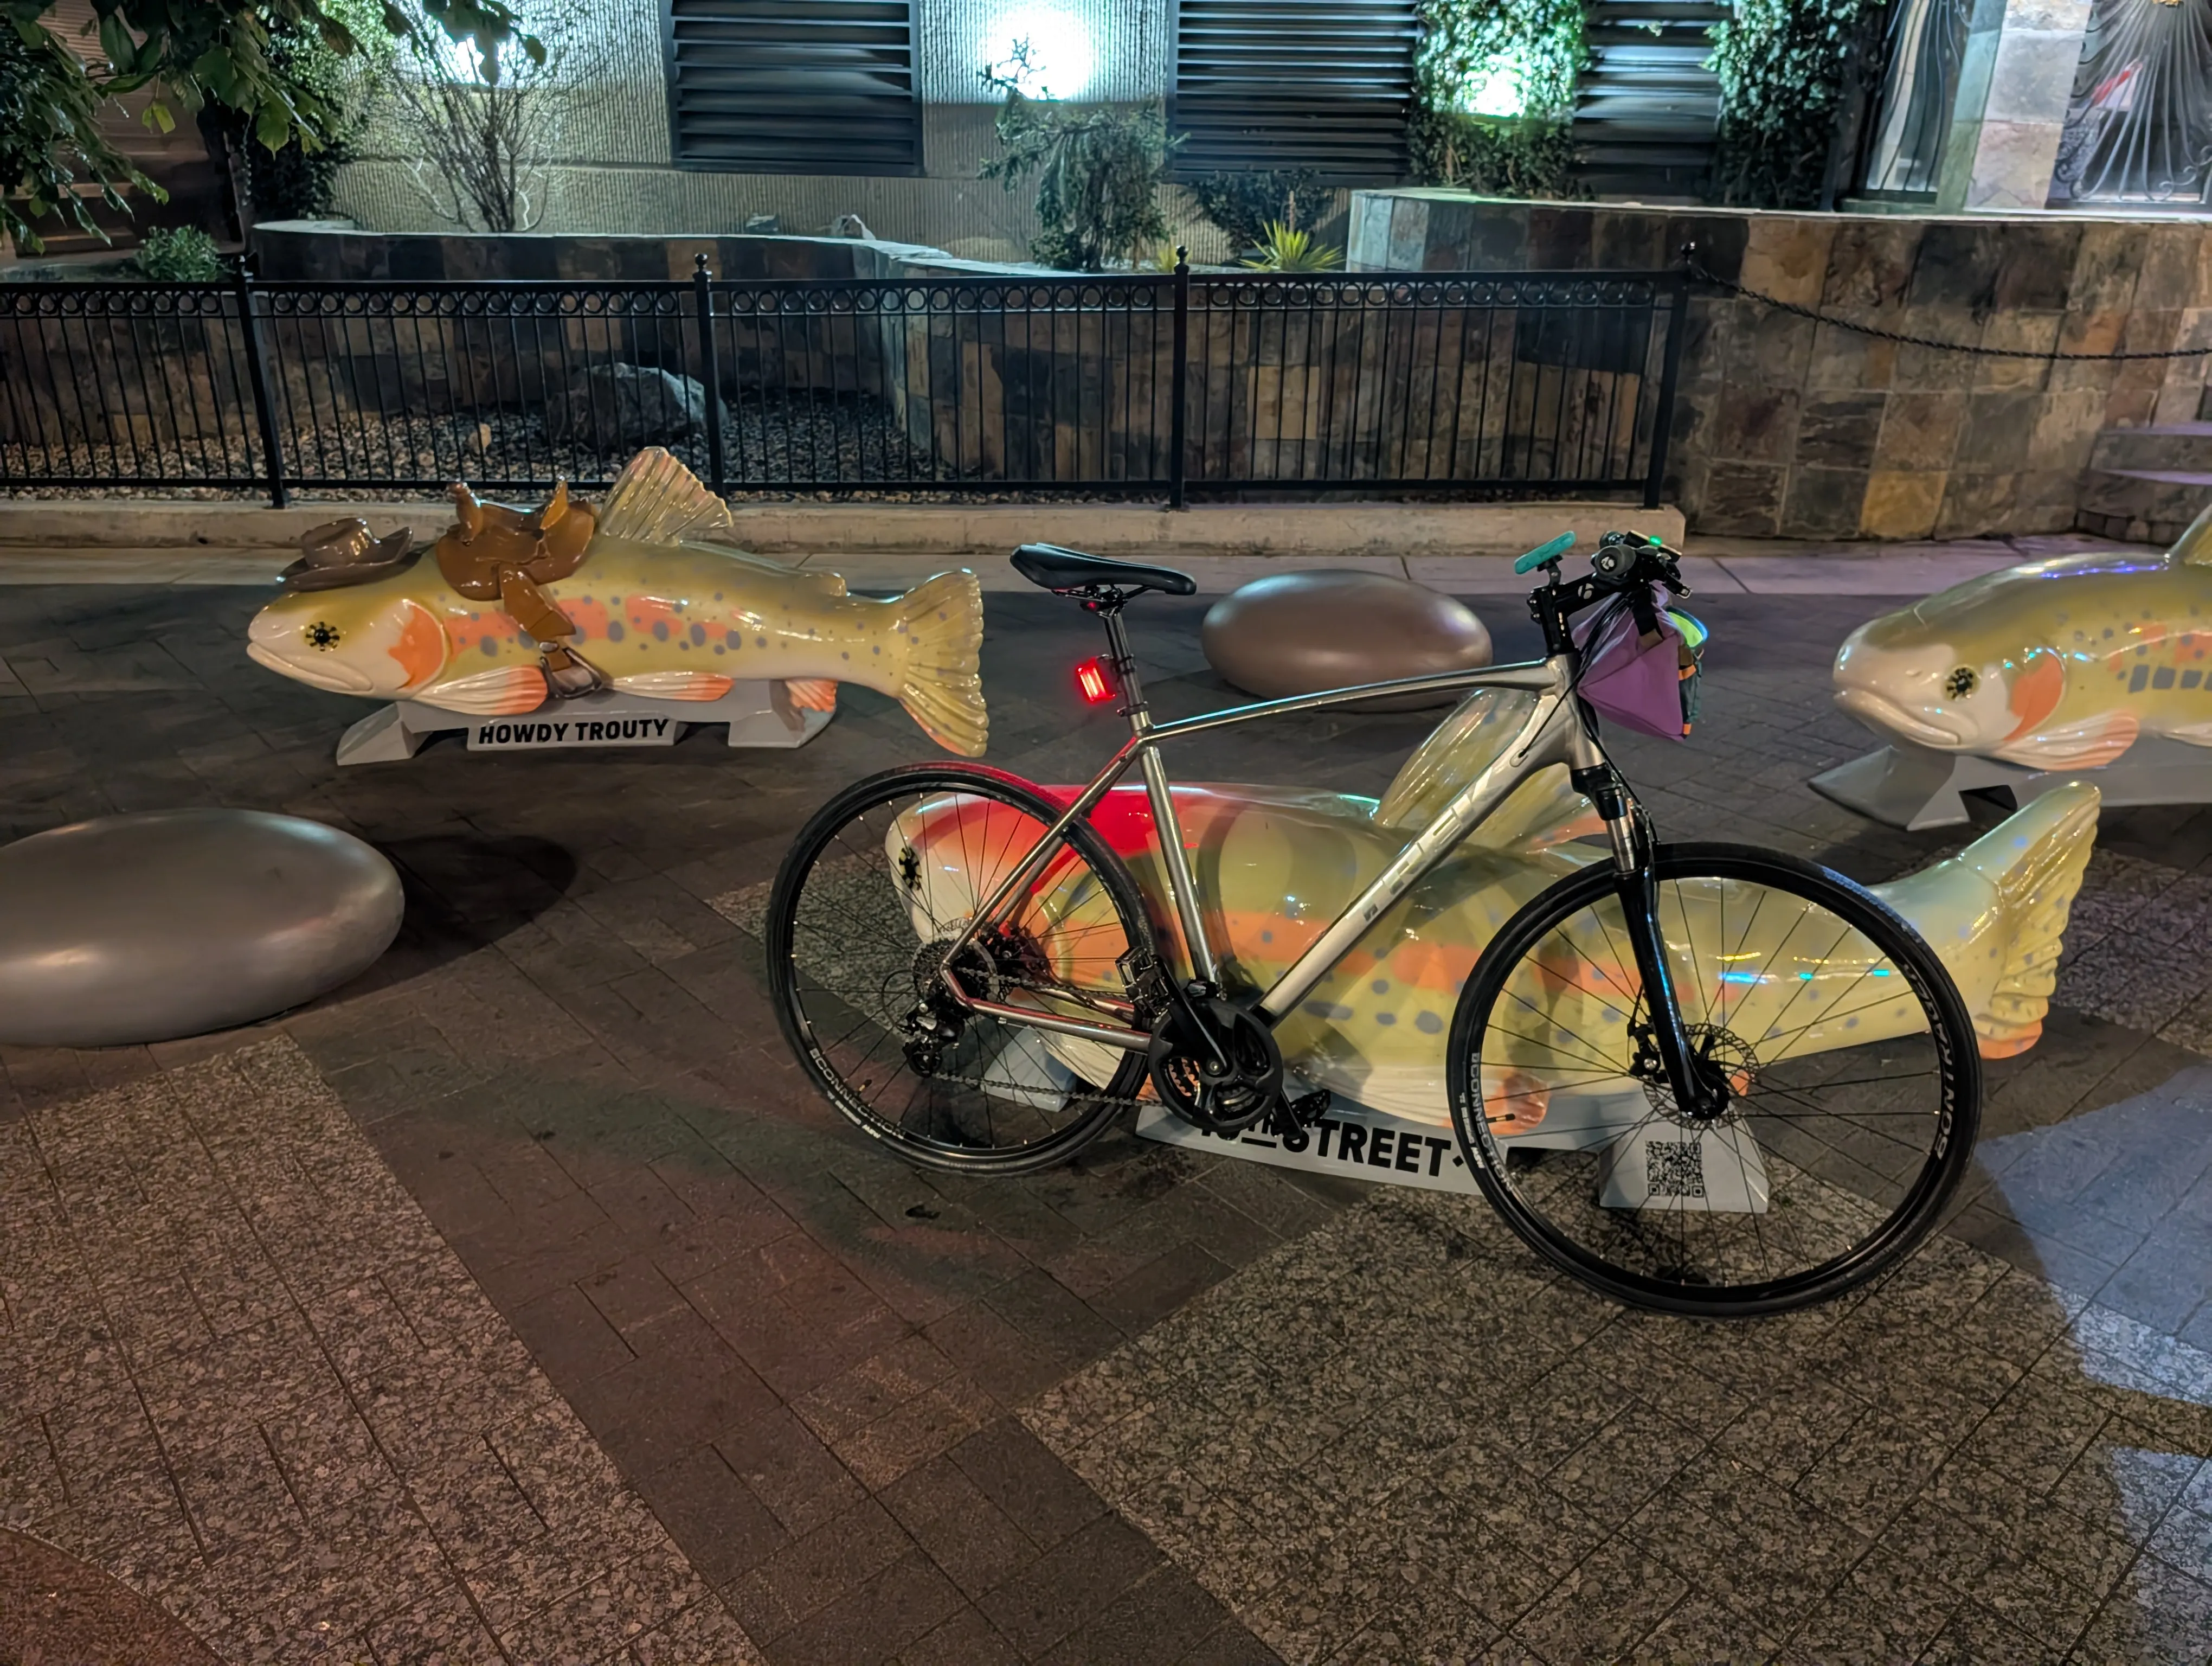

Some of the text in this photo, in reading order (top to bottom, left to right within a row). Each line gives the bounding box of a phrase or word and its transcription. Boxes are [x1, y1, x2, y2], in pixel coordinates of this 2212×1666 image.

[478, 719, 669, 744] HOWDY TROUTY
[1345, 765, 1503, 922] TREK
[815, 1058, 907, 1140] CONNECTION
[1470, 1062, 1514, 1192] CONNECTION
[1903, 963, 1955, 1161] BONTRAGER
